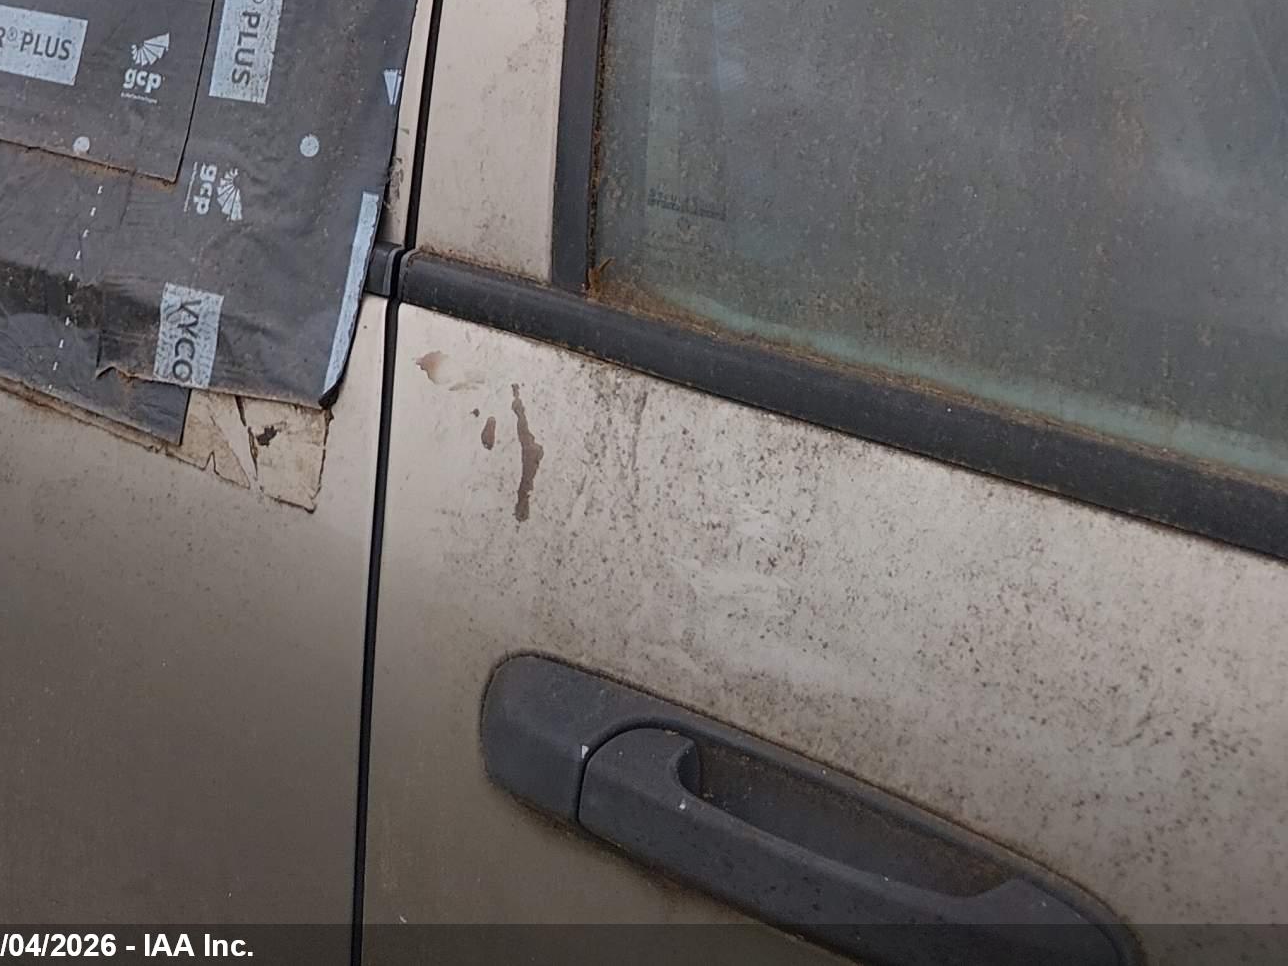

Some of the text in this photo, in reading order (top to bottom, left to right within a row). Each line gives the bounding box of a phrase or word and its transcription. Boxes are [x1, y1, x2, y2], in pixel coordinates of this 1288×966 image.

[19, 31, 73, 62] PLUS
[231, 10, 261, 87] PLUS
[122, 68, 162, 94] gcp
[193, 164, 218, 216] gcp
